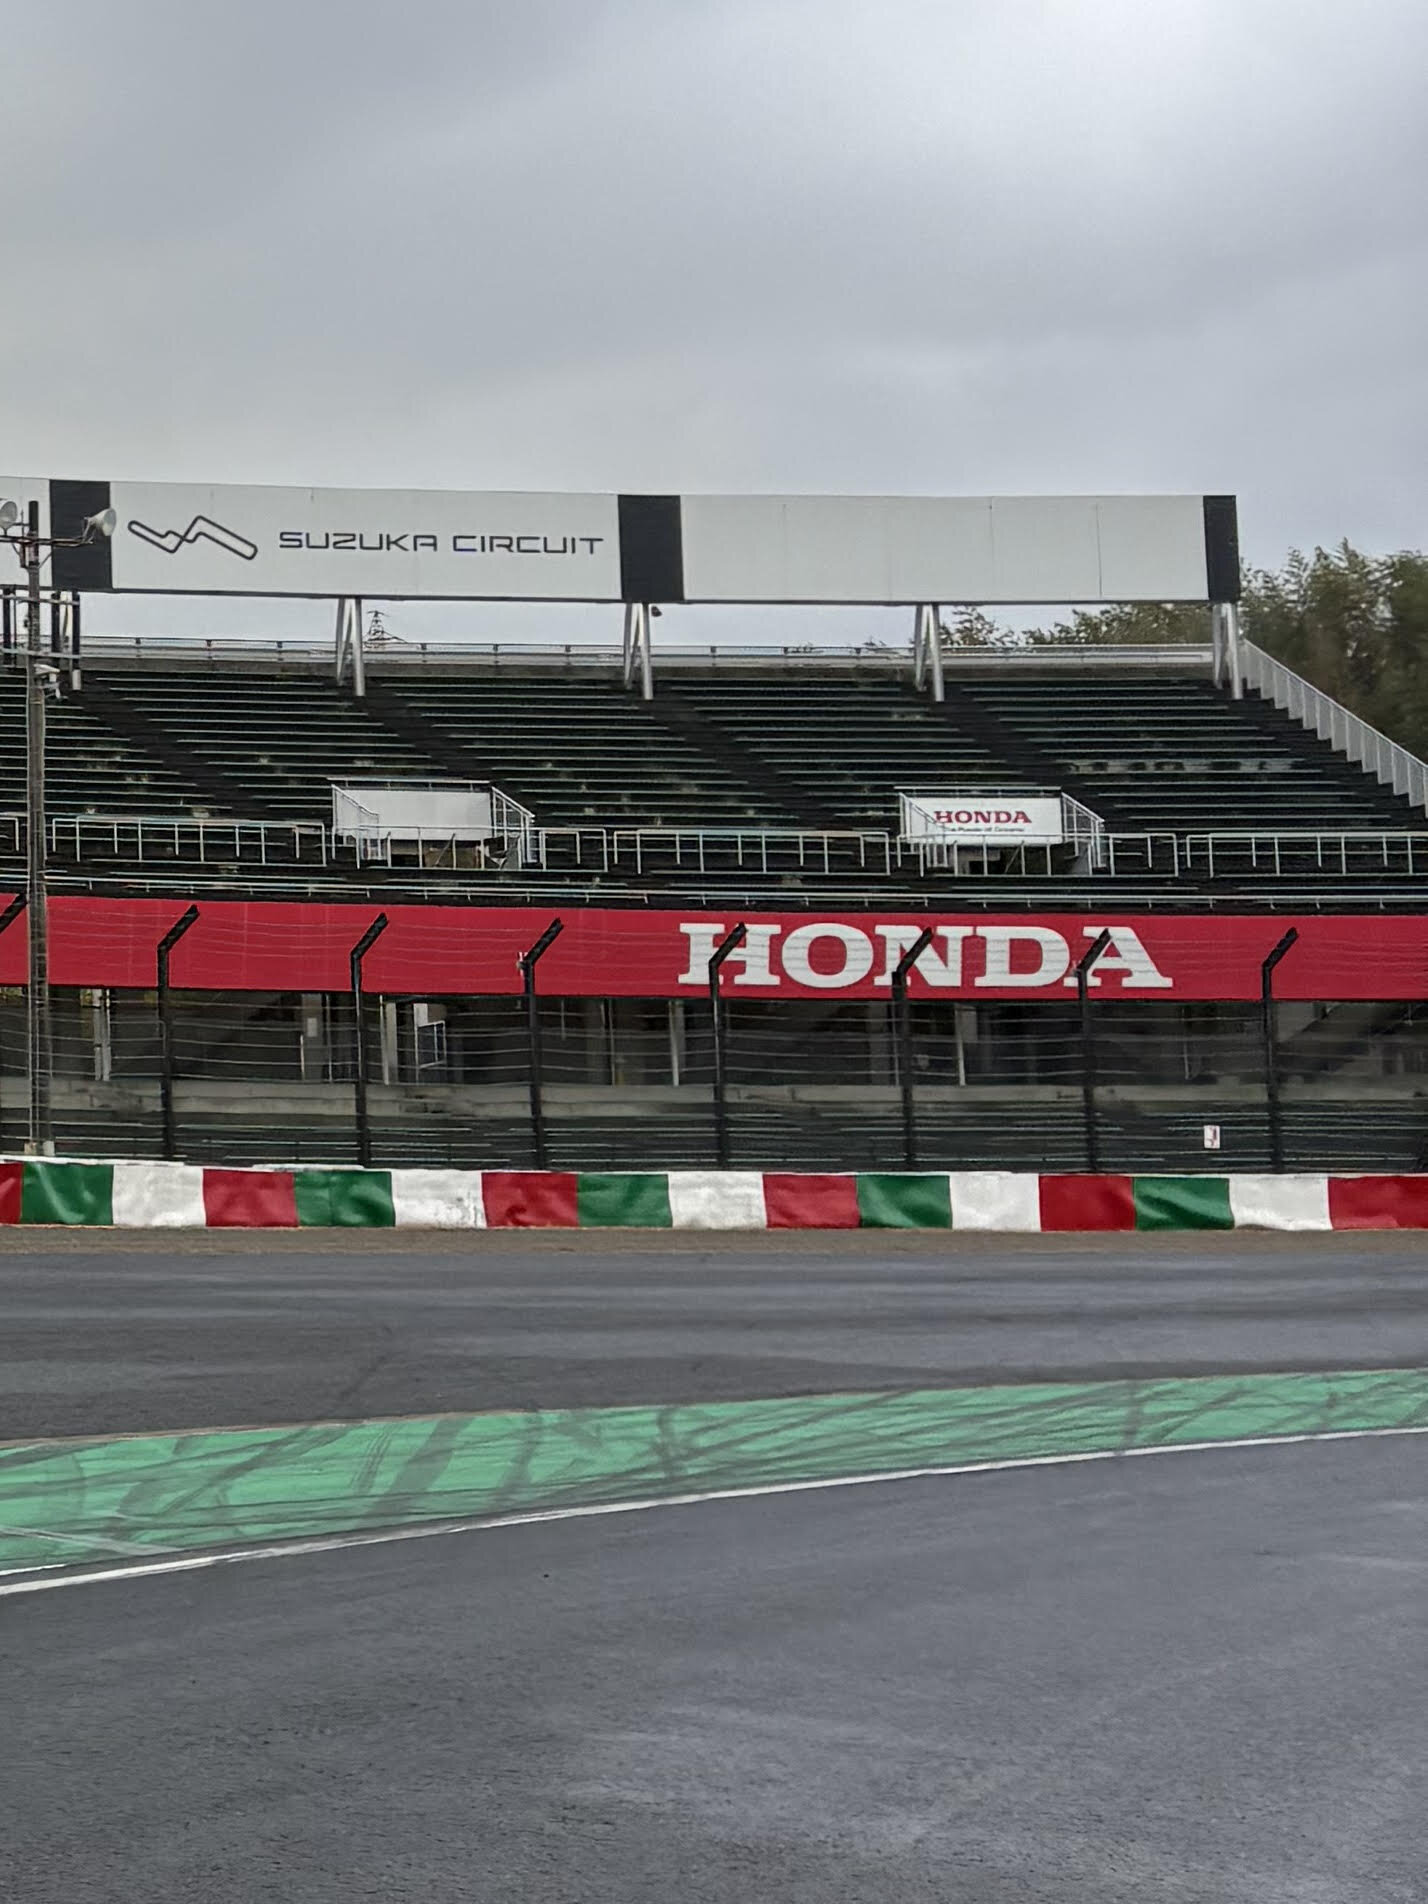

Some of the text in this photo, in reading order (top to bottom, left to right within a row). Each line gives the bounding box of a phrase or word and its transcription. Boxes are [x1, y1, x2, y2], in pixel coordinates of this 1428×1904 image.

[279, 531, 604, 555] SUZUKA CIRCUIT
[933, 810, 1033, 824] HONDA
[677, 922, 1173, 988] HONDA
